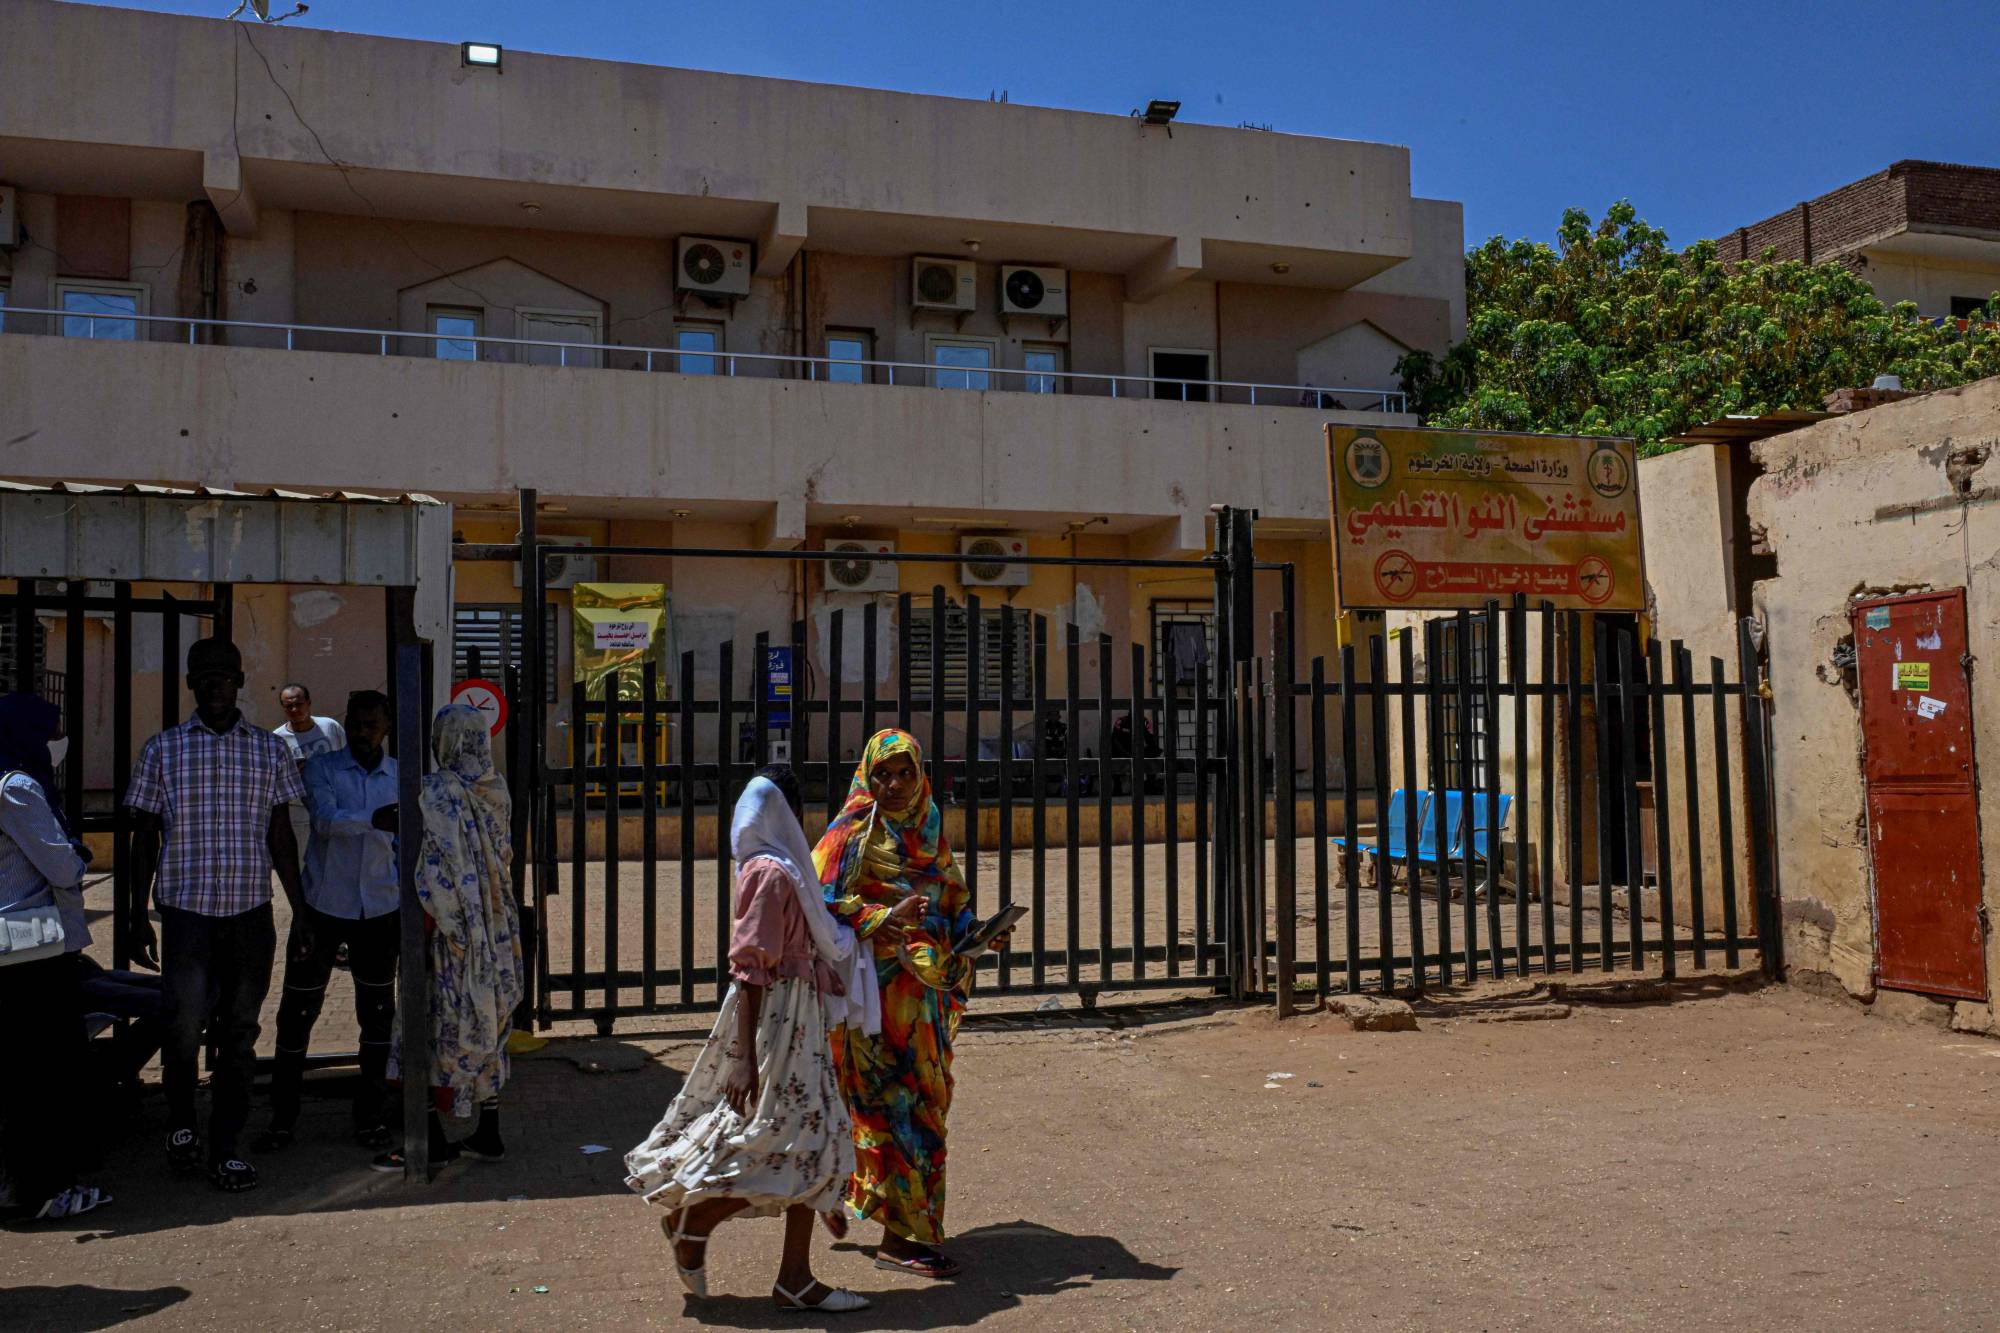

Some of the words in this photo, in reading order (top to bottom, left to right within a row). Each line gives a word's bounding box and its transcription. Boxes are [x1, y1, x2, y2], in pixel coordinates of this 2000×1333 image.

[1408, 453, 1459, 475] الخرطوم
[1461, 453, 1492, 477] ولاية
[1503, 455, 1540, 473] الصحة
[1541, 459, 1569, 479] وزارة
[1346, 489, 1460, 546] التعليمي
[1463, 494, 1518, 539] النو
[1523, 491, 1626, 541] مستشفى
[1425, 565, 1486, 589] السلاح
[1487, 566, 1530, 589] دخول
[1533, 567, 1569, 592] يمنع
